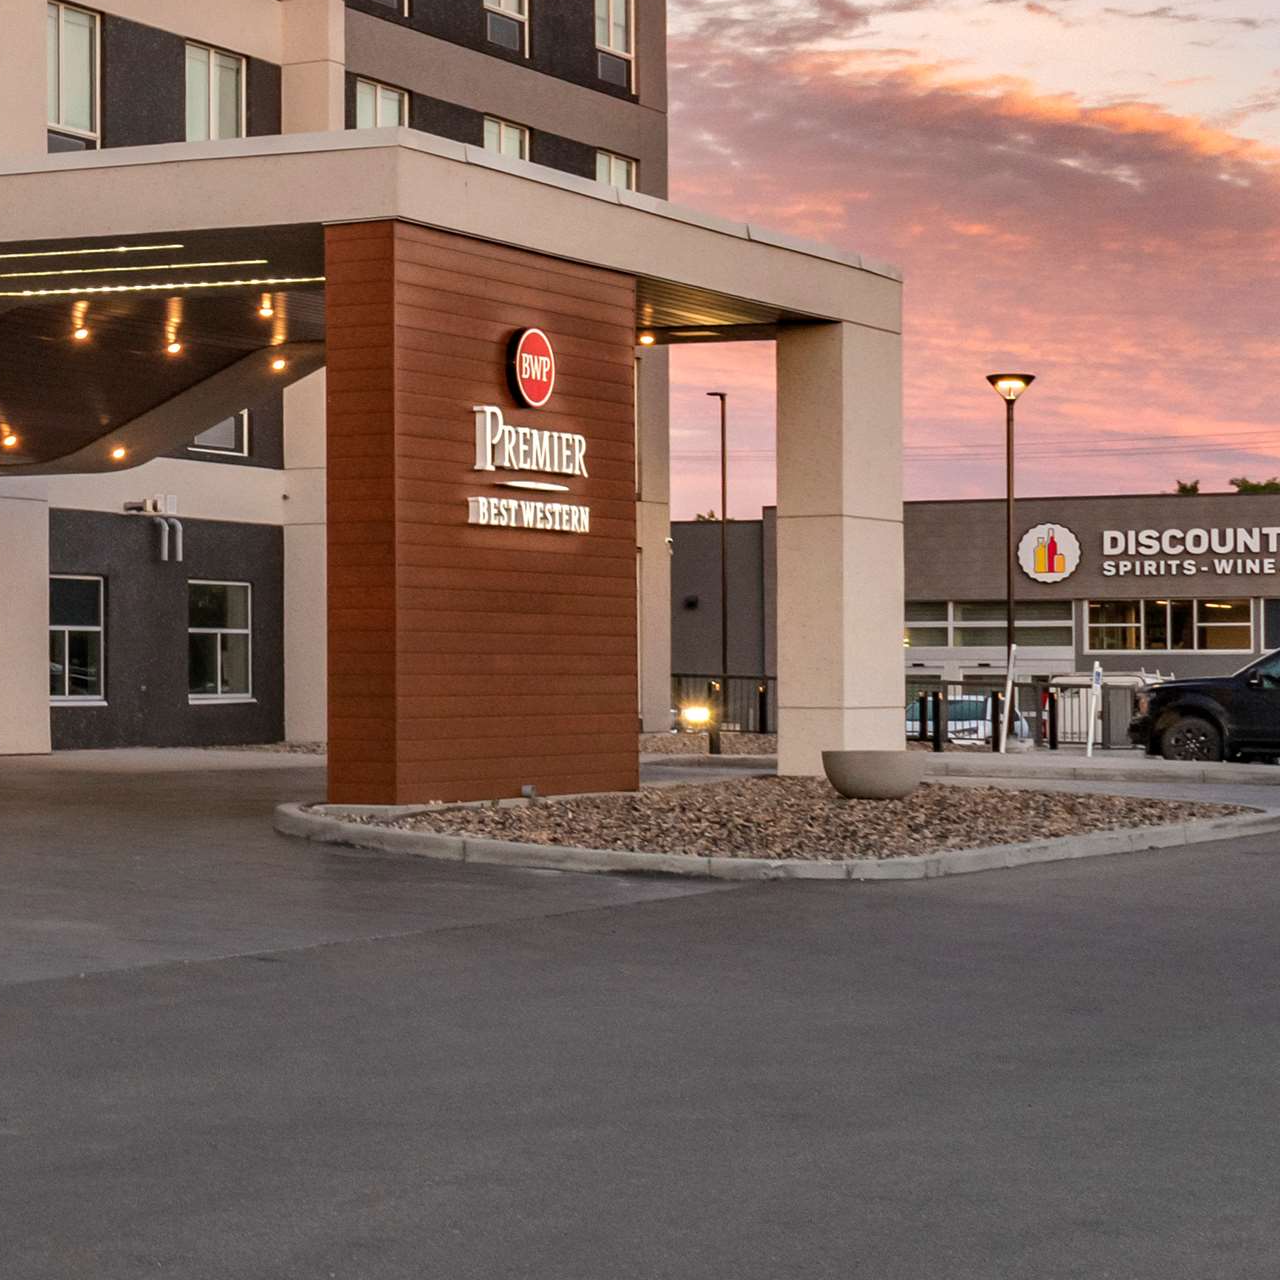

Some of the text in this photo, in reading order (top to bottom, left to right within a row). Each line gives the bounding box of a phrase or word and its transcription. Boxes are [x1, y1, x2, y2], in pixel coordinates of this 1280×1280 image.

[521, 352, 551, 382] BWP
[472, 405, 589, 478] PREMIER
[467, 496, 590, 533] BEST WESTERN
[1102, 526, 1280, 556] DISCOUNT
